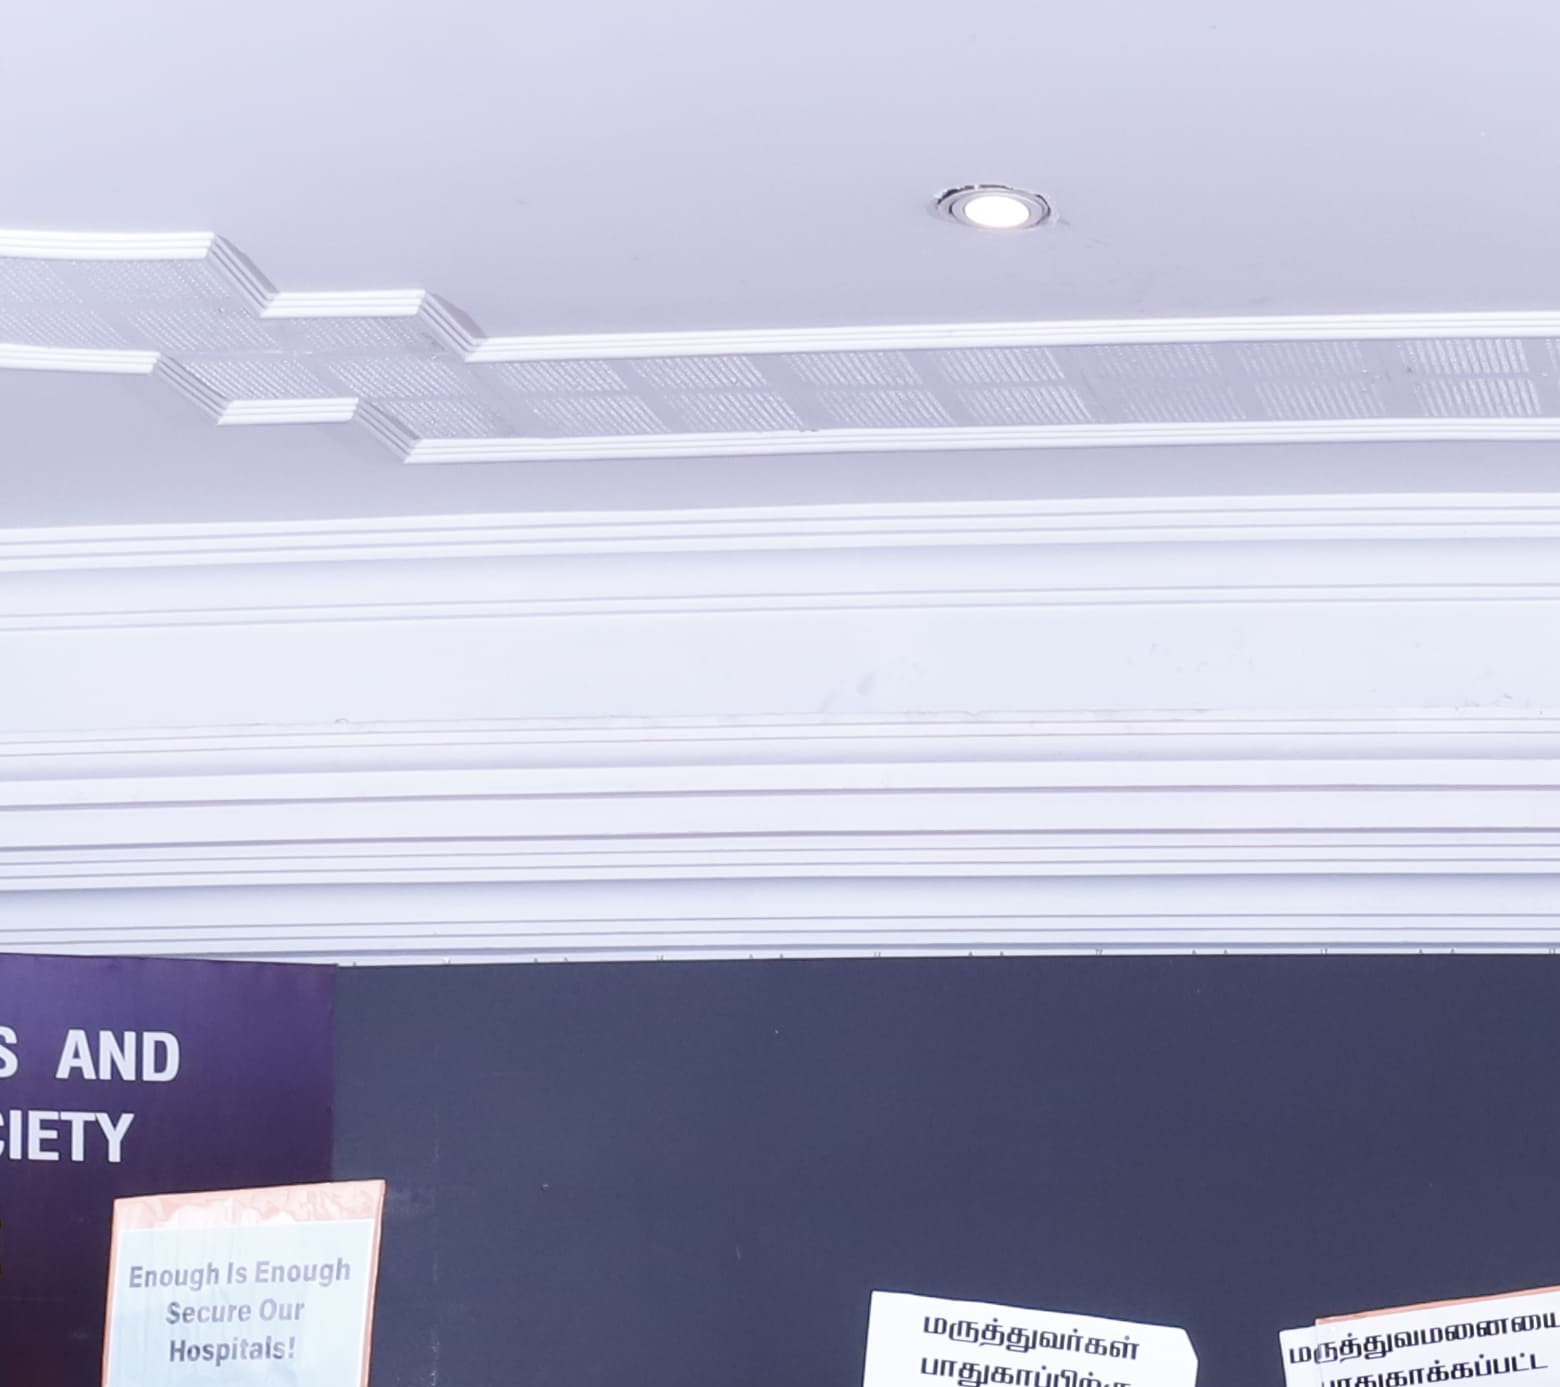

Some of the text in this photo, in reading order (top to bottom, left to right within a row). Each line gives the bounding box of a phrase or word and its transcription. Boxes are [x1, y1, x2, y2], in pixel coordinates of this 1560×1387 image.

[56, 1030, 180, 1082] AND
[129, 1258, 350, 1291] Enough Is Enough
[166, 1299, 304, 1325] Secure Our
[169, 1335, 295, 1366] Hospitals!
[923, 1315, 1140, 1360] மருத்துவர்கள்
